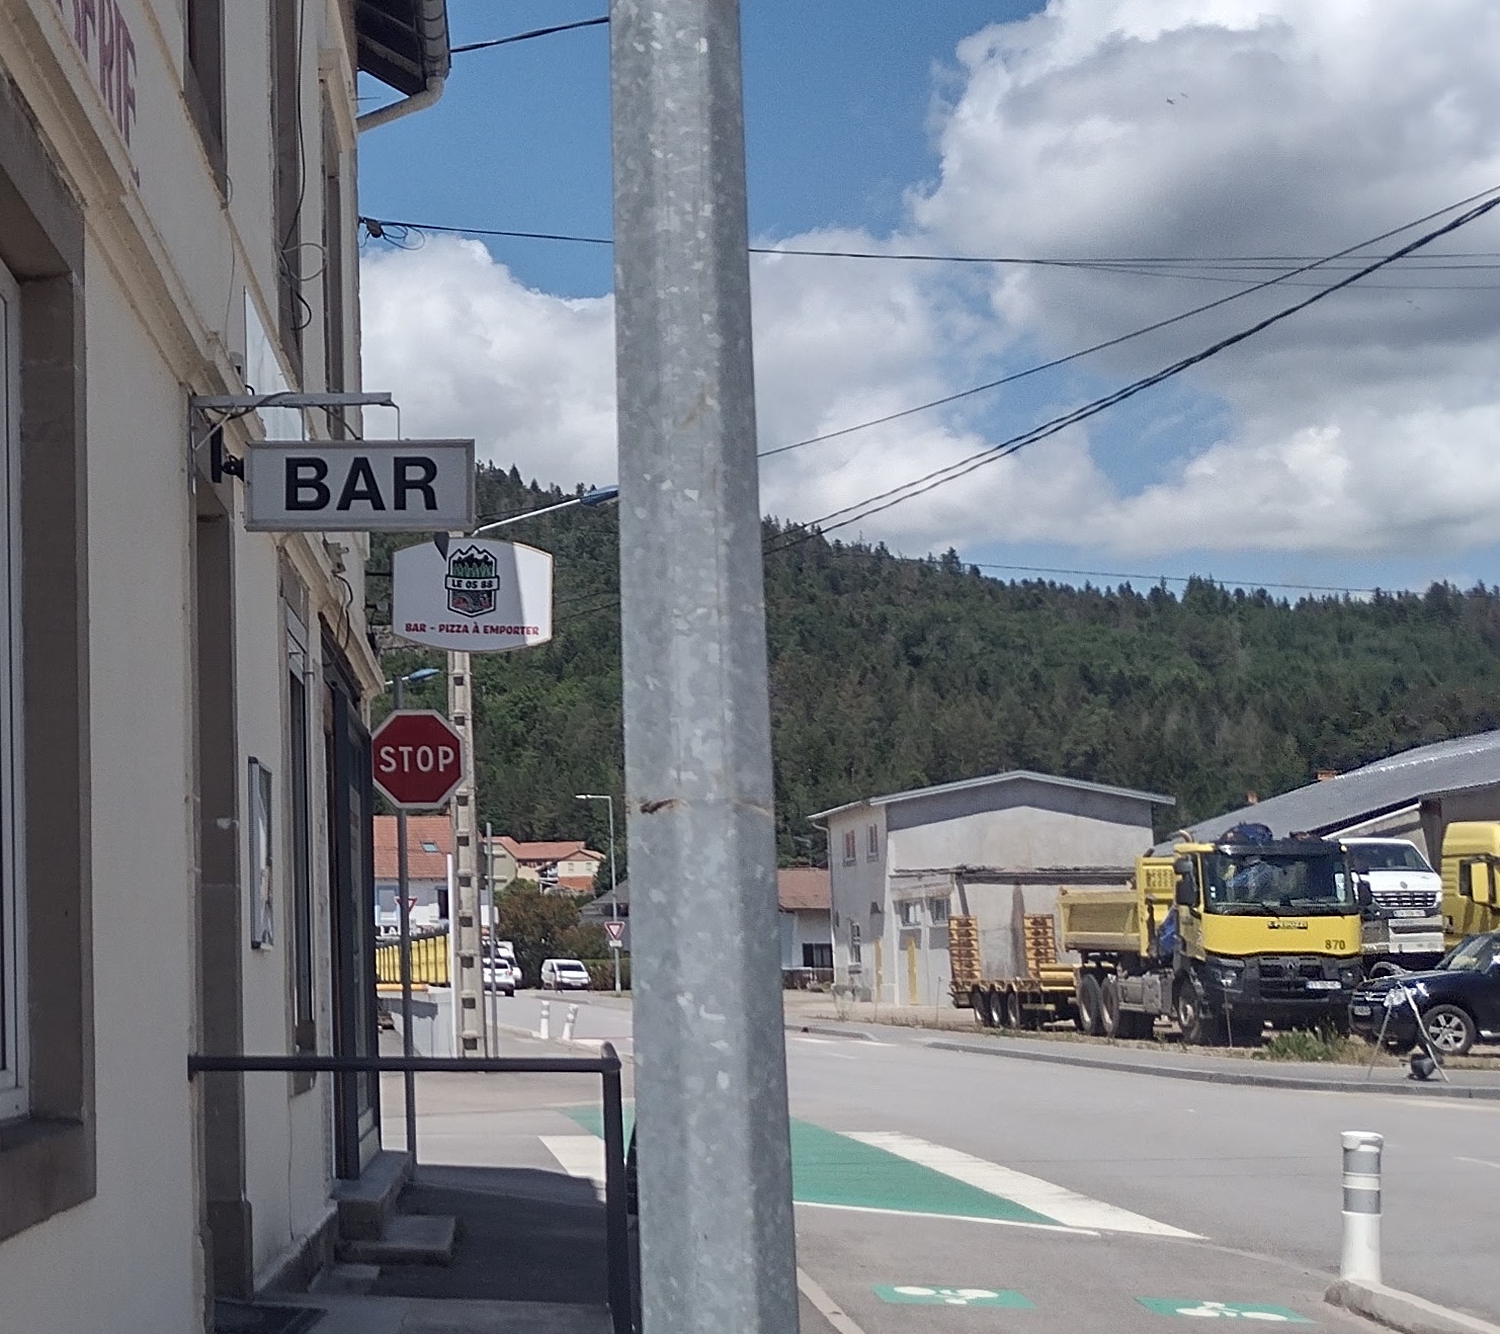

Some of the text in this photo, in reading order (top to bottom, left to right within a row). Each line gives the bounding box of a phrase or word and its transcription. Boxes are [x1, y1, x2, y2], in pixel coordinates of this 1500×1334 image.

[285, 456, 438, 511] BAR
[452, 579, 462, 588] LE
[405, 623, 426, 633] BAR
[438, 624, 469, 634] PIZZA
[472, 621, 480, 634] À
[483, 625, 539, 635] EMPORTER
[379, 746, 455, 772] STOP
[1325, 939, 1346, 950] 870
